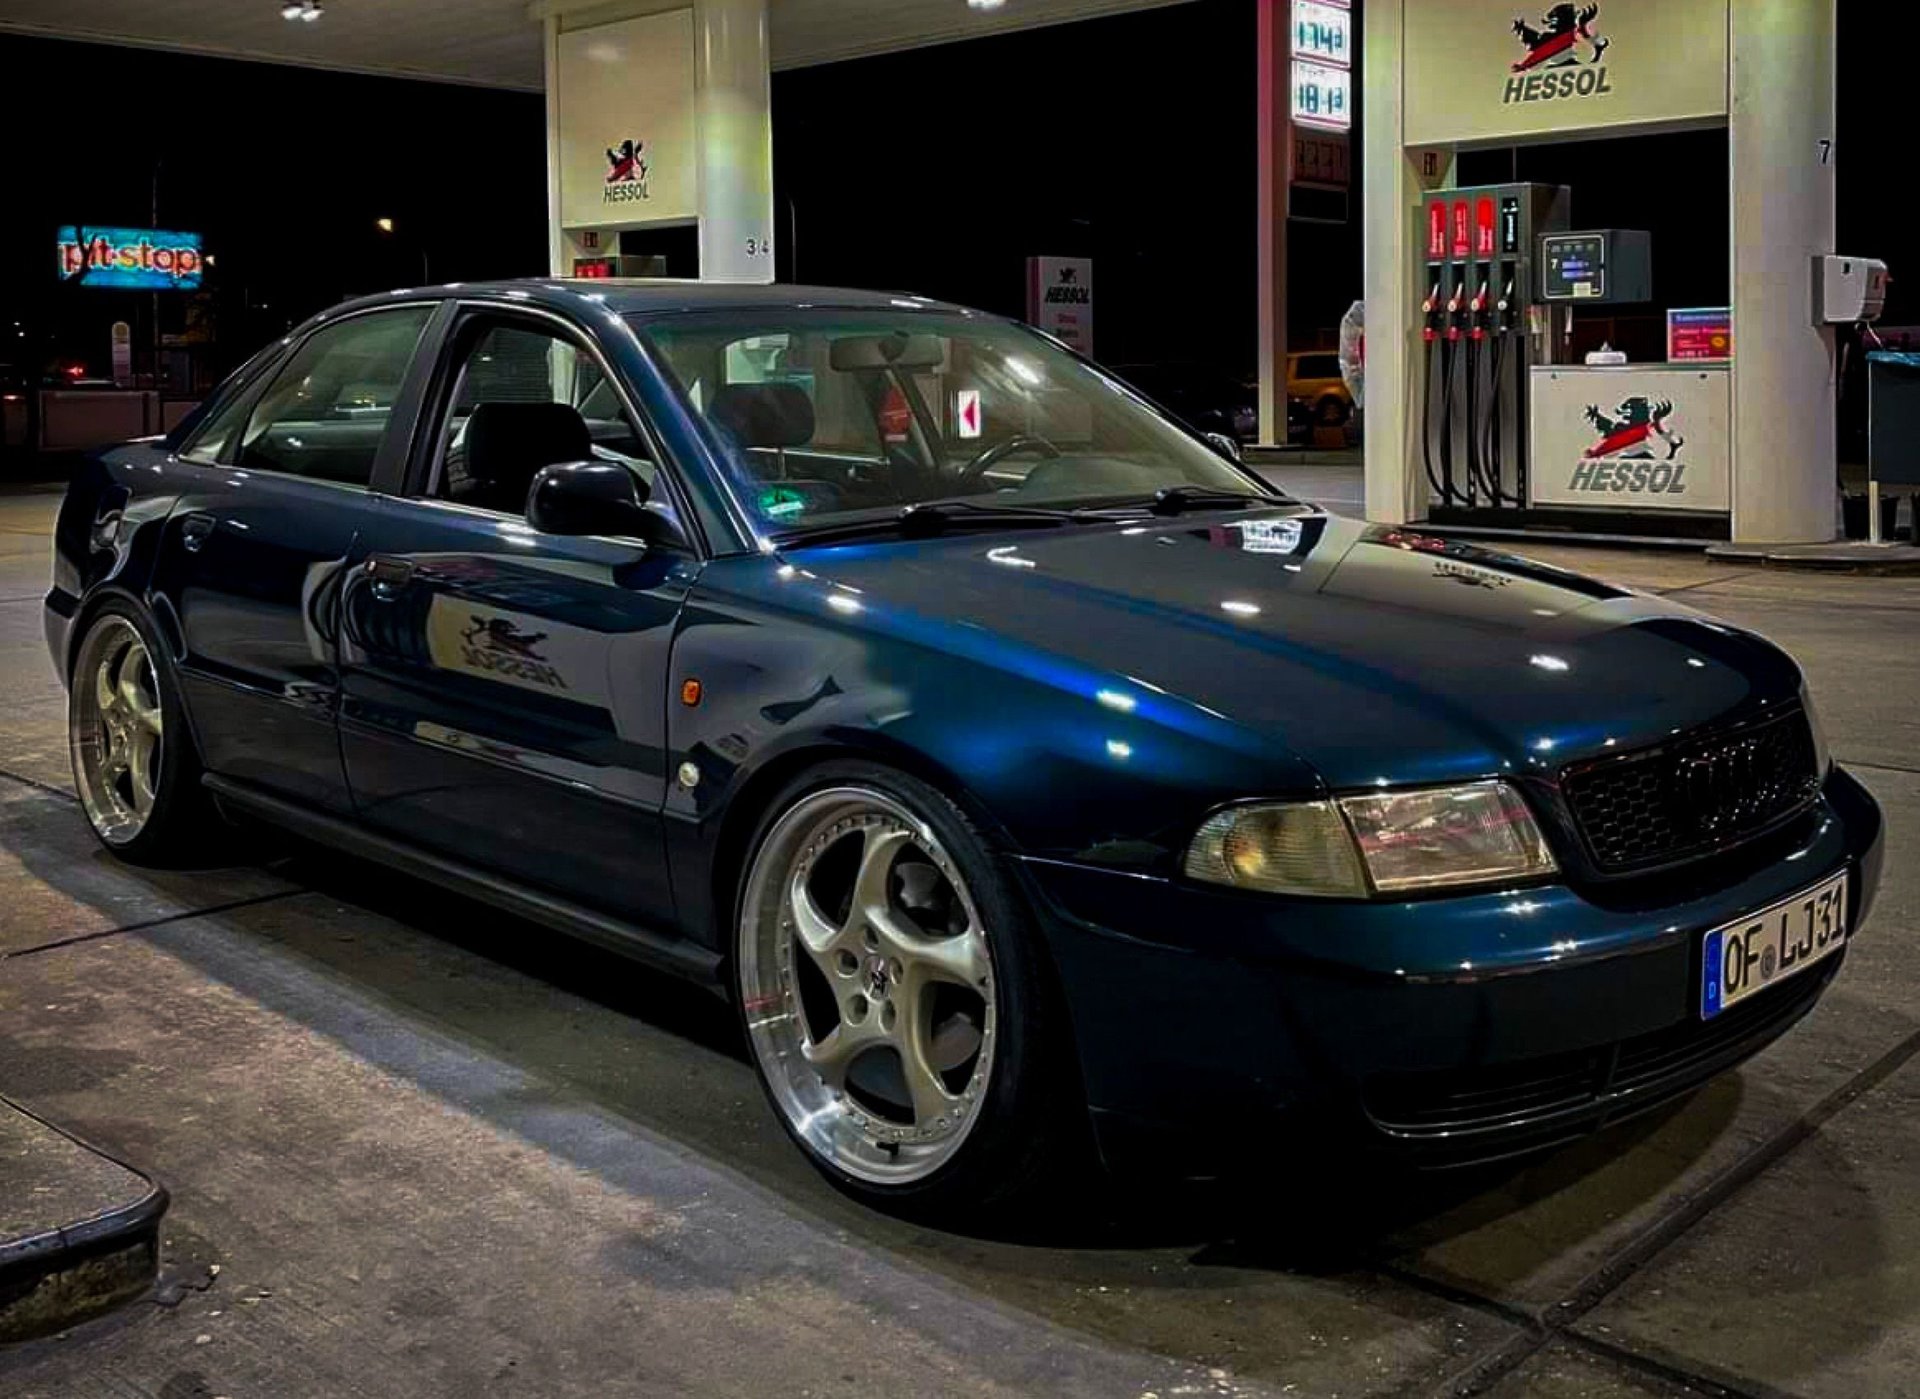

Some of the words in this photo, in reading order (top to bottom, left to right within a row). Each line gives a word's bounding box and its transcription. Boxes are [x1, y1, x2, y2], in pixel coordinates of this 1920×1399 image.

[1502, 67, 1611, 104] HESSOL
[1818, 140, 1830, 164] 7
[603, 182, 649, 204] HESSOL
[746, 238, 756, 256] 3
[1568, 462, 1686, 494] HESSOL
[1724, 922, 1763, 995] OF
